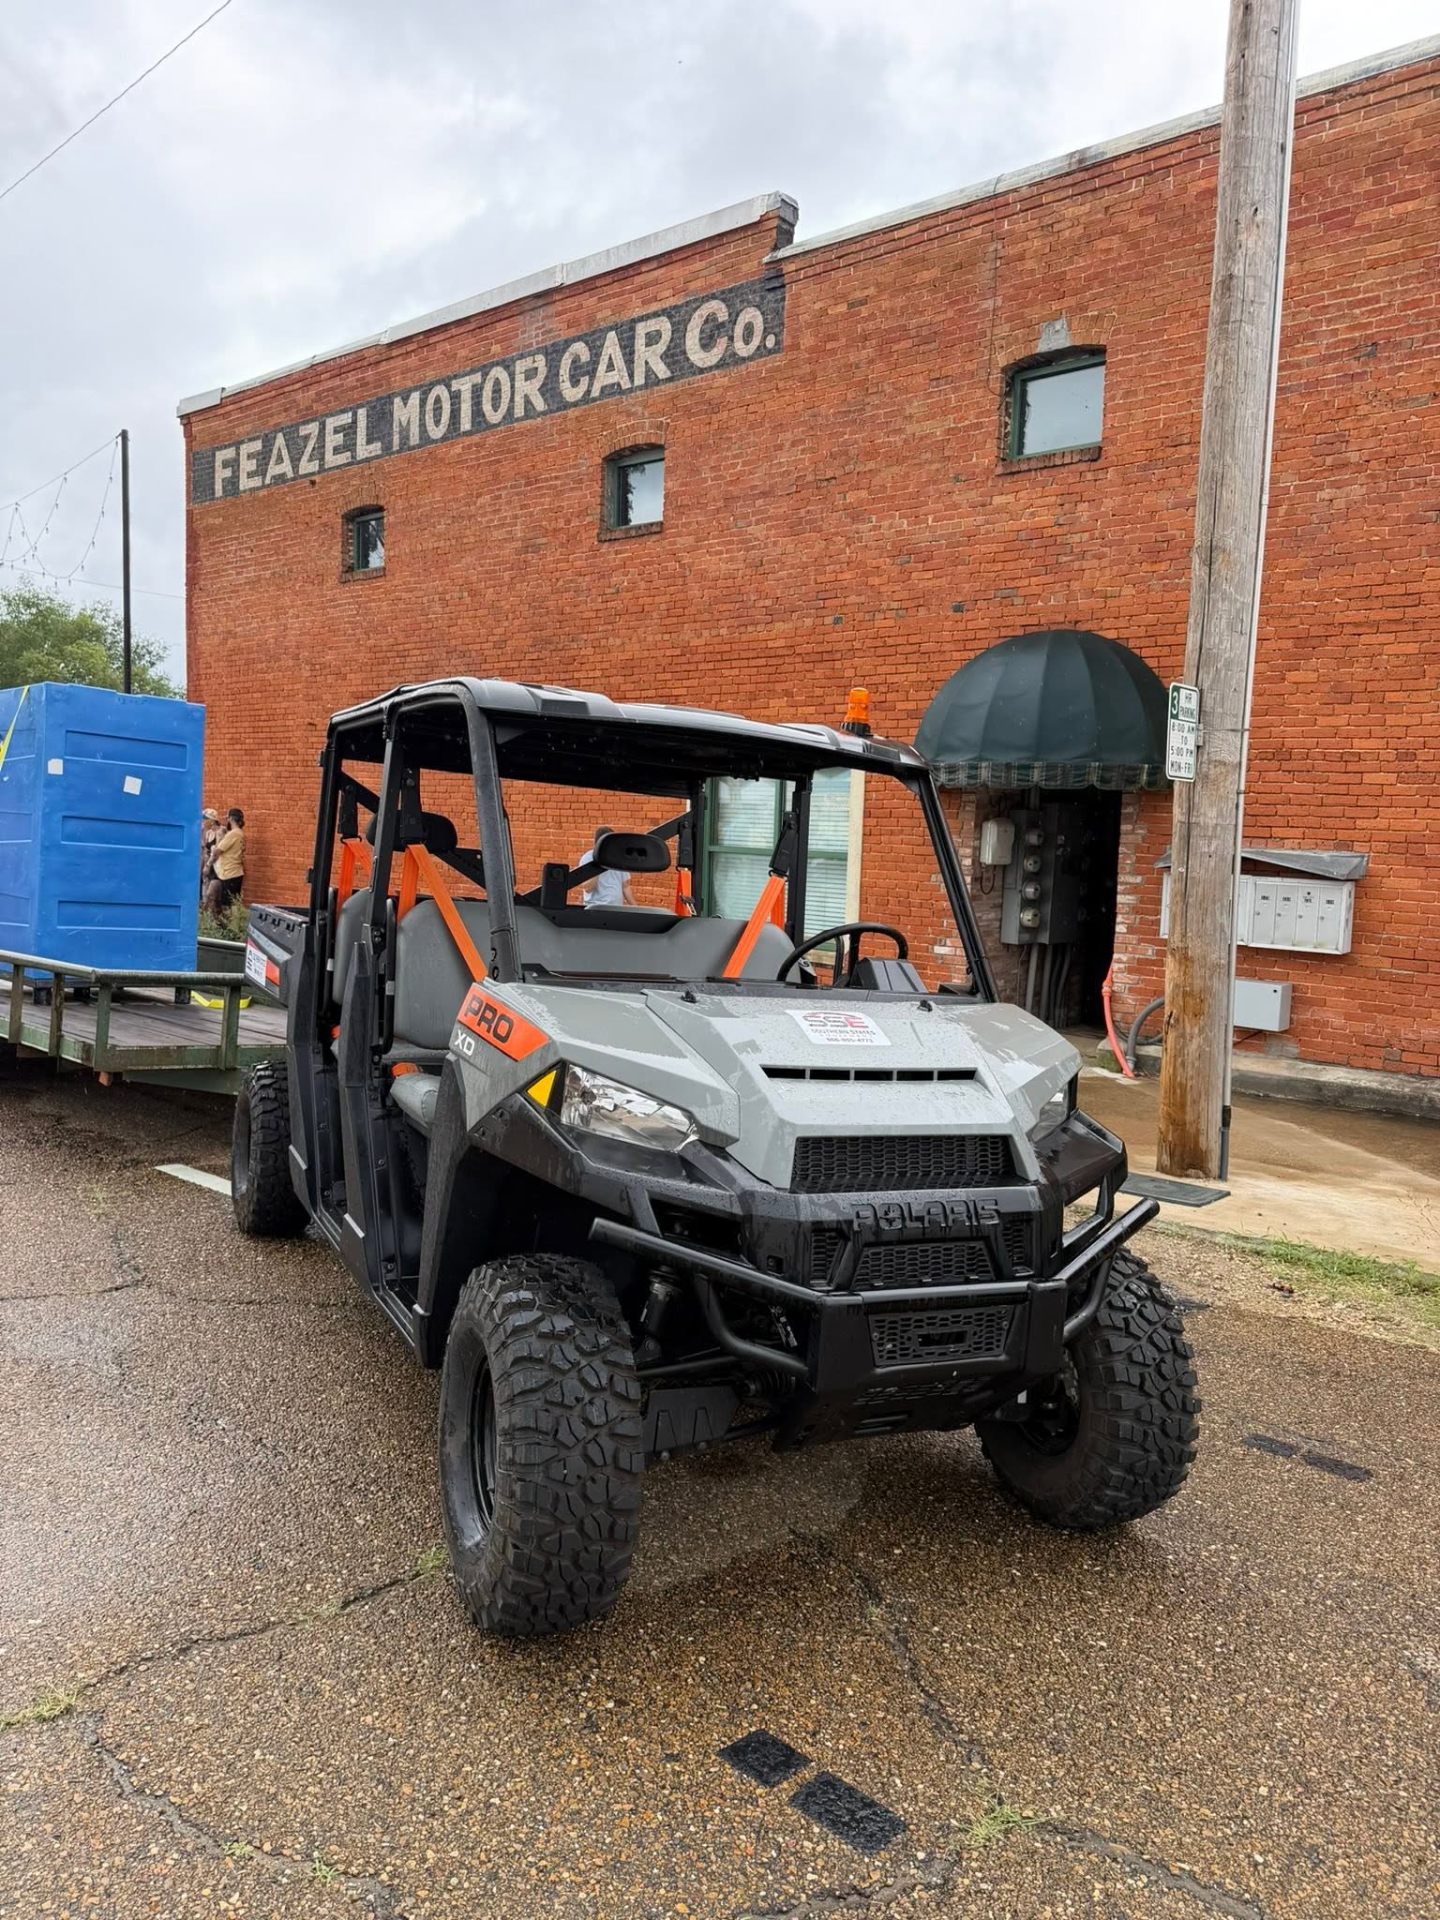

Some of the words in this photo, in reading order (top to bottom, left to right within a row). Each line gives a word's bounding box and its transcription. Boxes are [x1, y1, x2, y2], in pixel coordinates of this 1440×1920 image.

[213, 410, 383, 498] FEAZEL
[393, 353, 548, 452] MOTOR
[558, 315, 674, 403] CAR
[1171, 691, 1179, 715] 3
[1180, 705, 1196, 720] PARKING
[1171, 721, 1186, 733] 8:00
[1187, 724, 1195, 734] AM
[1181, 735, 1189, 746] TO
[1170, 745, 1184, 757] 5:00
[1185, 748, 1194, 758] PM
[1170, 760, 1192, 775] MON-FRI
[464, 993, 515, 1044] PRO
[454, 1029, 476, 1056] XD
[851, 1199, 1000, 1232] POLARIS
